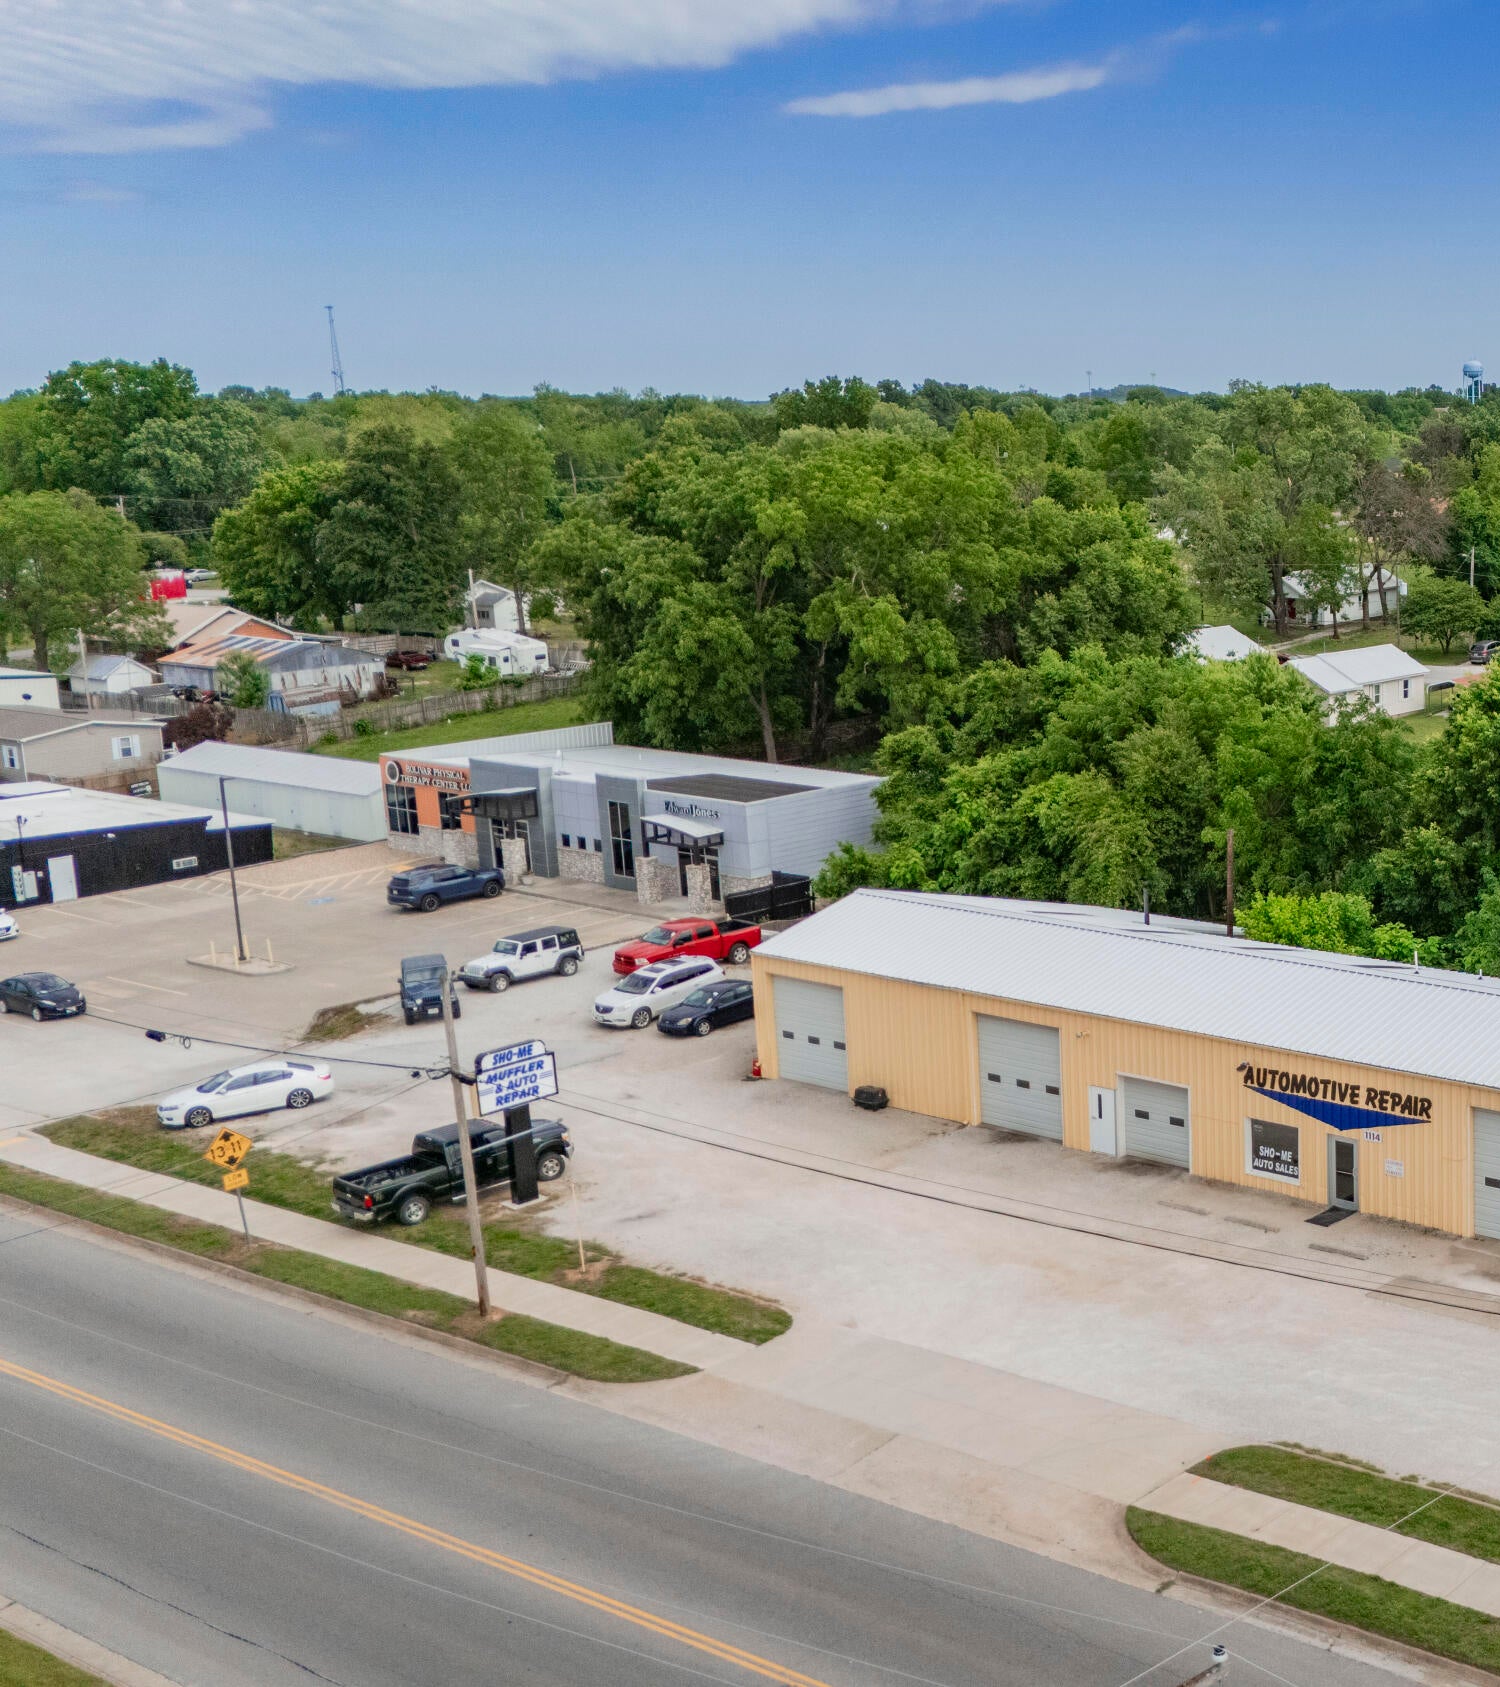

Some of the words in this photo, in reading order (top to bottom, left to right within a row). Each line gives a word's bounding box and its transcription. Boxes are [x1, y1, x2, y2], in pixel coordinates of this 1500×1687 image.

[400, 775, 431, 785] THERAPY
[406, 766, 432, 775] BOLIVAR
[433, 768, 465, 781] PHYSICAL
[693, 806, 720, 818] Jones
[492, 1045, 533, 1065] SHO-ME
[486, 1060, 544, 1083] MUFFLER
[495, 1084, 503, 1094] &
[506, 1073, 538, 1091] AUTO
[1243, 1065, 1361, 1105] AUTOMOTIVE
[1365, 1087, 1433, 1120] REPAIR
[495, 1085, 540, 1106] REPAIR
[1365, 1131, 1381, 1142] 1114
[1259, 1145, 1293, 1162] SHO-ME
[1253, 1157, 1274, 1170] AUTO
[1275, 1162, 1299, 1176] SALES
